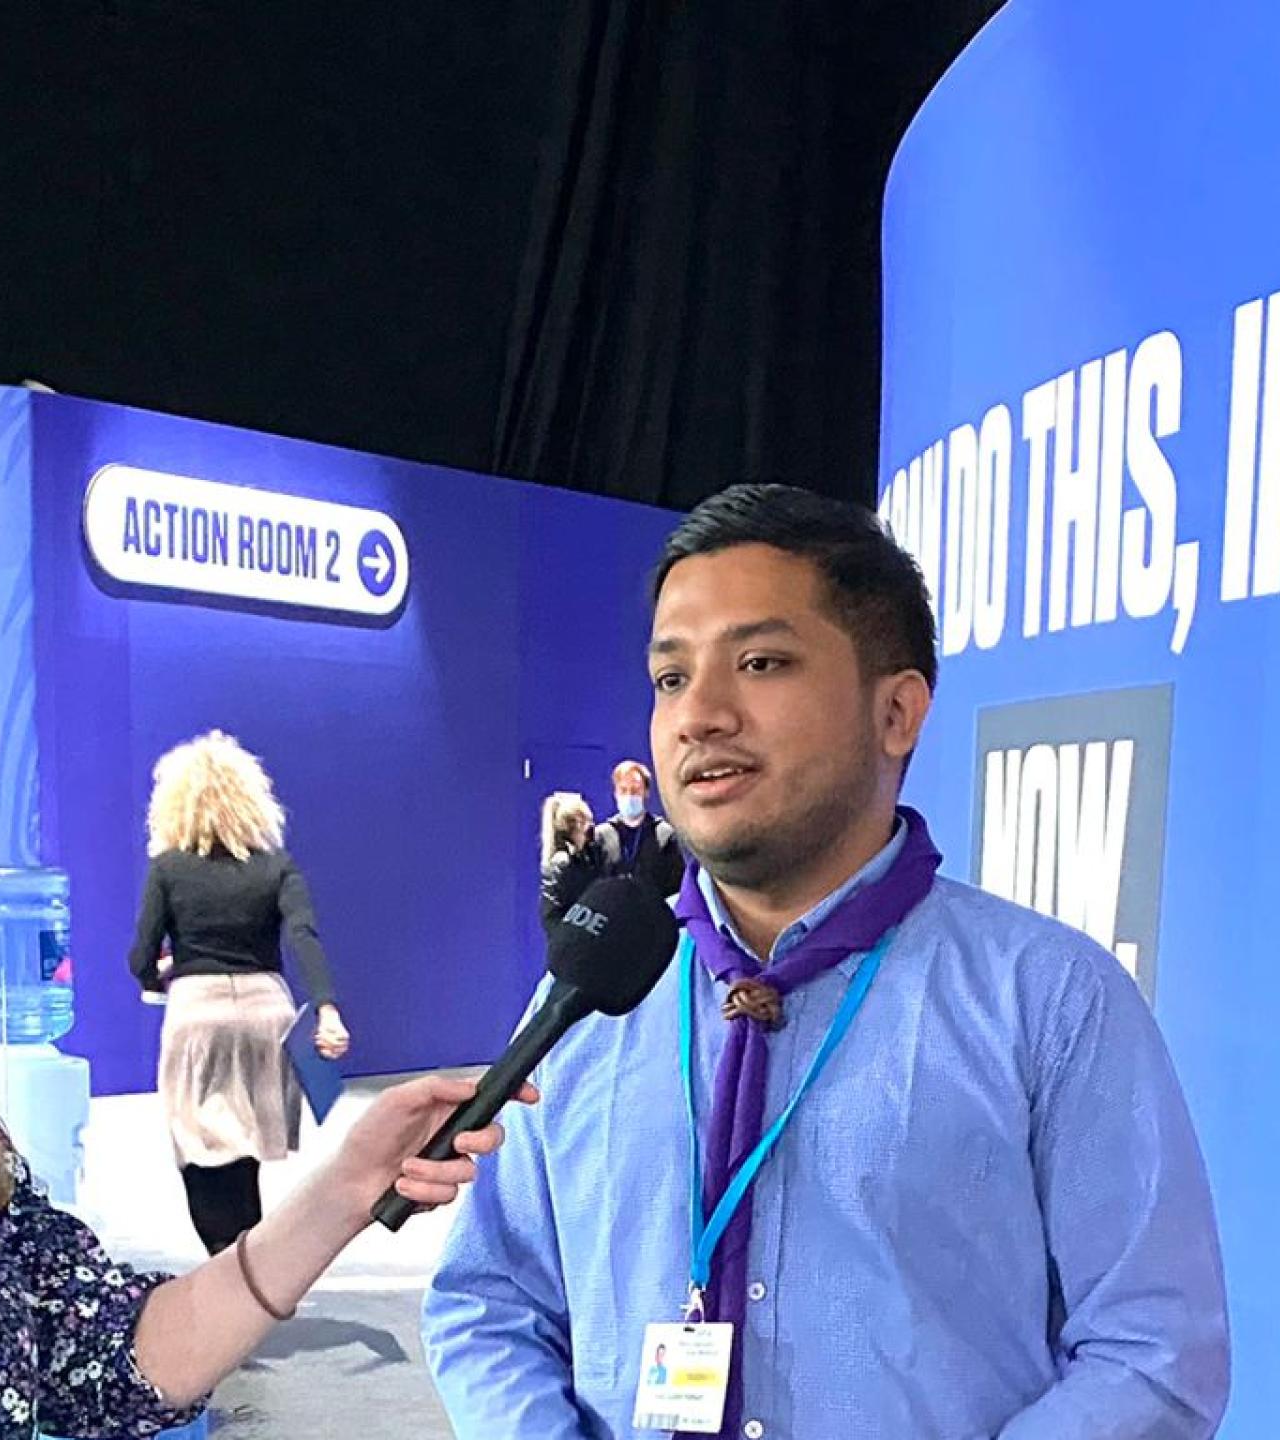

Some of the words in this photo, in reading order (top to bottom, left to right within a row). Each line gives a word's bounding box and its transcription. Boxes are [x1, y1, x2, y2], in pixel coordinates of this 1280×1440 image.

[123, 496, 229, 567] ACTION
[238, 514, 317, 580] ROOM
[326, 529, 341, 583] 2
[942, 402, 1012, 657] DO
[1021, 330, 1199, 655] THIS,
